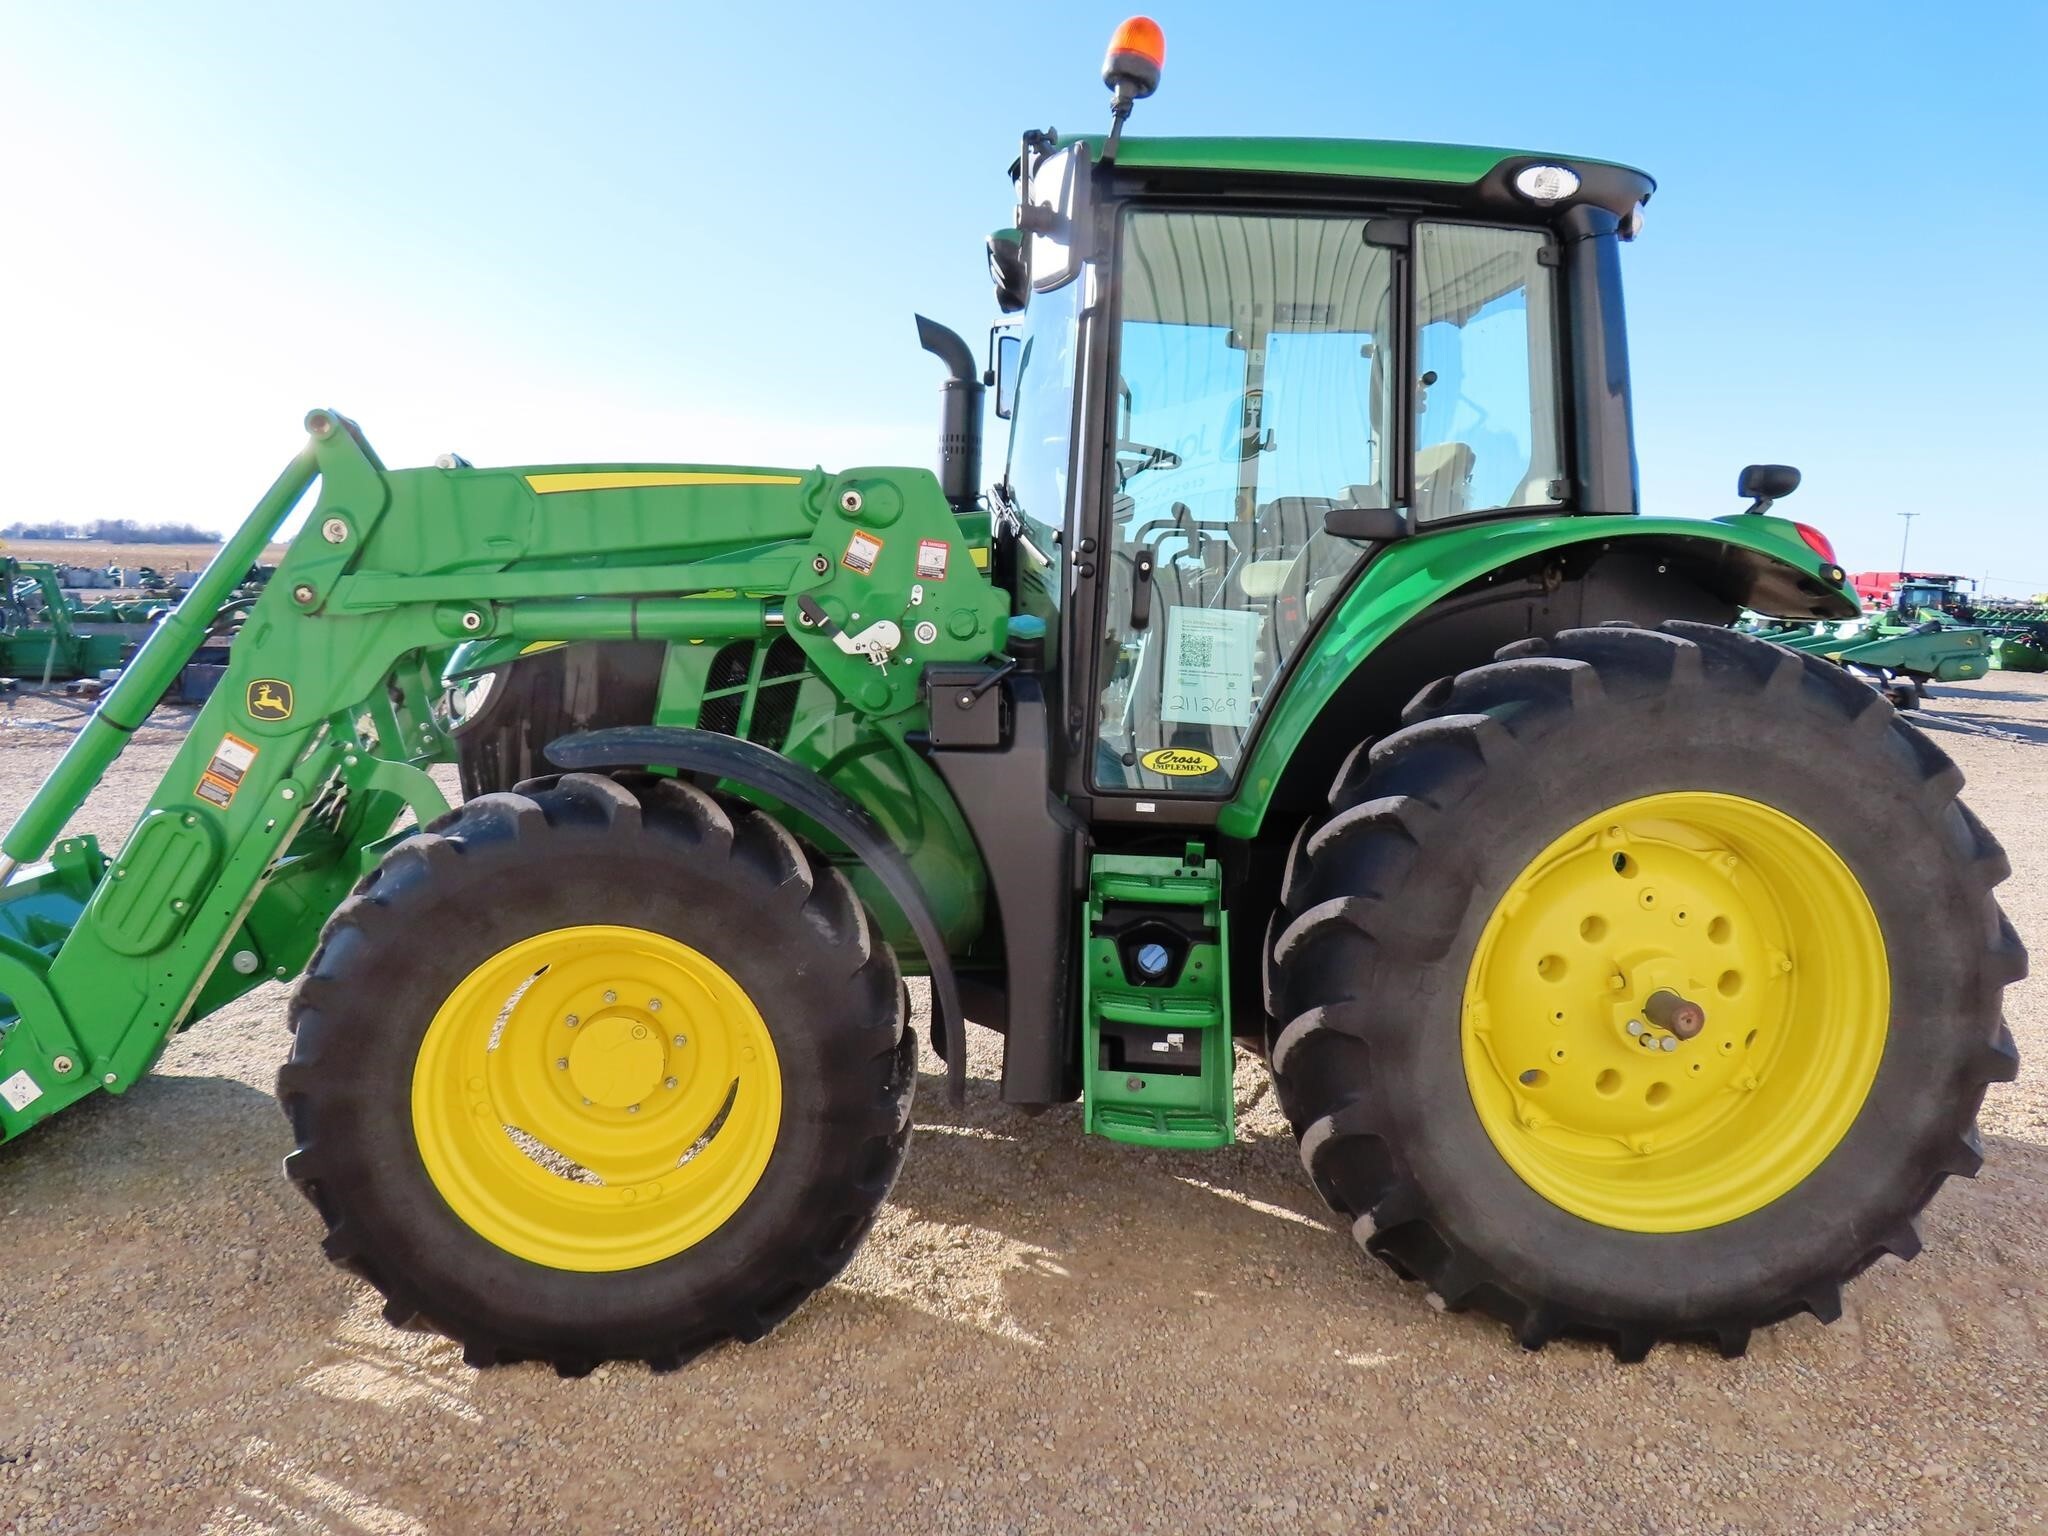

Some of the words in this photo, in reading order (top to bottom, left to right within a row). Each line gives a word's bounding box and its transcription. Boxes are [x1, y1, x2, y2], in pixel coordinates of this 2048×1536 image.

[1170, 695, 1237, 712] 211269
[1155, 750, 1203, 765] Cross
[1152, 763, 1209, 772] IMPLEMENT
